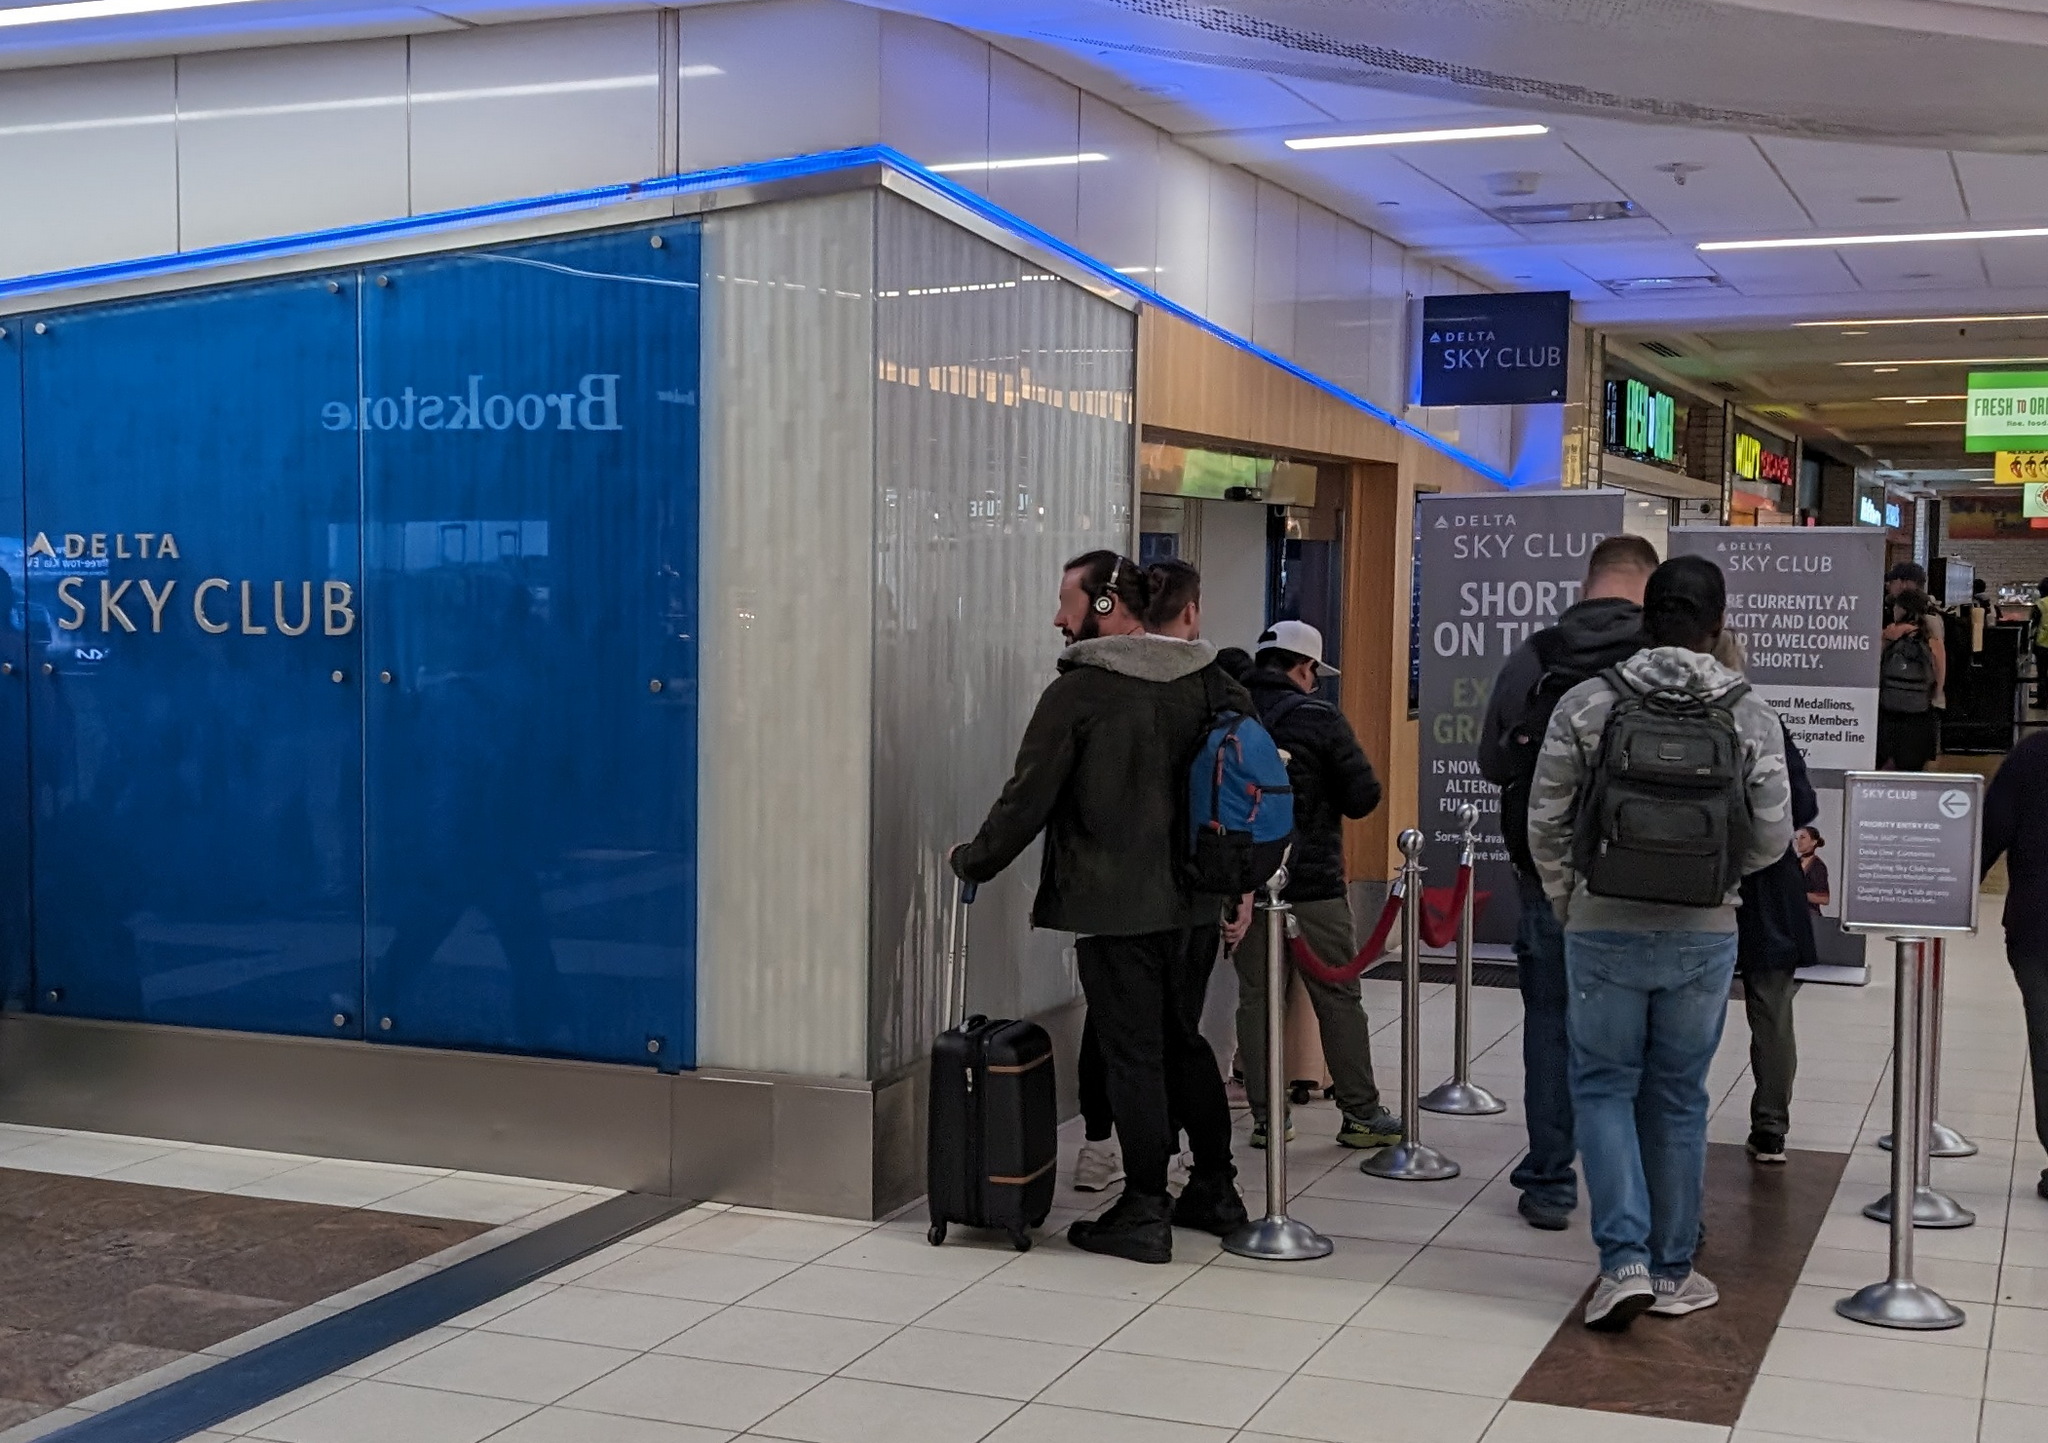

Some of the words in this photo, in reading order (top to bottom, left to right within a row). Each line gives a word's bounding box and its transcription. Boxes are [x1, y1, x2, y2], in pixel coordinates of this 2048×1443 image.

[1446, 331, 1496, 342] DELTA
[1443, 348, 1490, 369] SKY
[1497, 347, 1561, 368] CLUB
[1975, 397, 2013, 417] FRESH
[2017, 399, 2027, 414] TO
[1455, 514, 1517, 527] DELTA
[64, 533, 180, 559] DELTA
[1454, 534, 1515, 559] SKY
[1730, 542, 1772, 551] DELTA
[1729, 555, 1770, 573] SKY
[1776, 555, 1832, 573] CLUB
[57, 577, 177, 633] SKY
[193, 577, 356, 636] CLUB
[1459, 581, 1583, 616] SHORT
[1748, 594, 1834, 610] CURRENTLY
[1837, 596, 1858, 610] AT
[1772, 614, 1804, 629] AND
[1808, 615, 1849, 630] LOOK
[1433, 622, 1485, 657] ON
[1752, 633, 1773, 647] TO
[1776, 633, 1870, 650] WELCOMING
[1752, 652, 1824, 669] SHORTLY.
[1794, 698, 1855, 711] Medallions,
[1433, 713, 1481, 744] GR
[1809, 714, 1859, 727] Members
[1845, 730, 1865, 743] line
[1432, 760, 1445, 774] IS
[1448, 760, 1480, 775] NOW
[1862, 788, 1886, 799] SKY
[1887, 789, 1917, 800] CLUB
